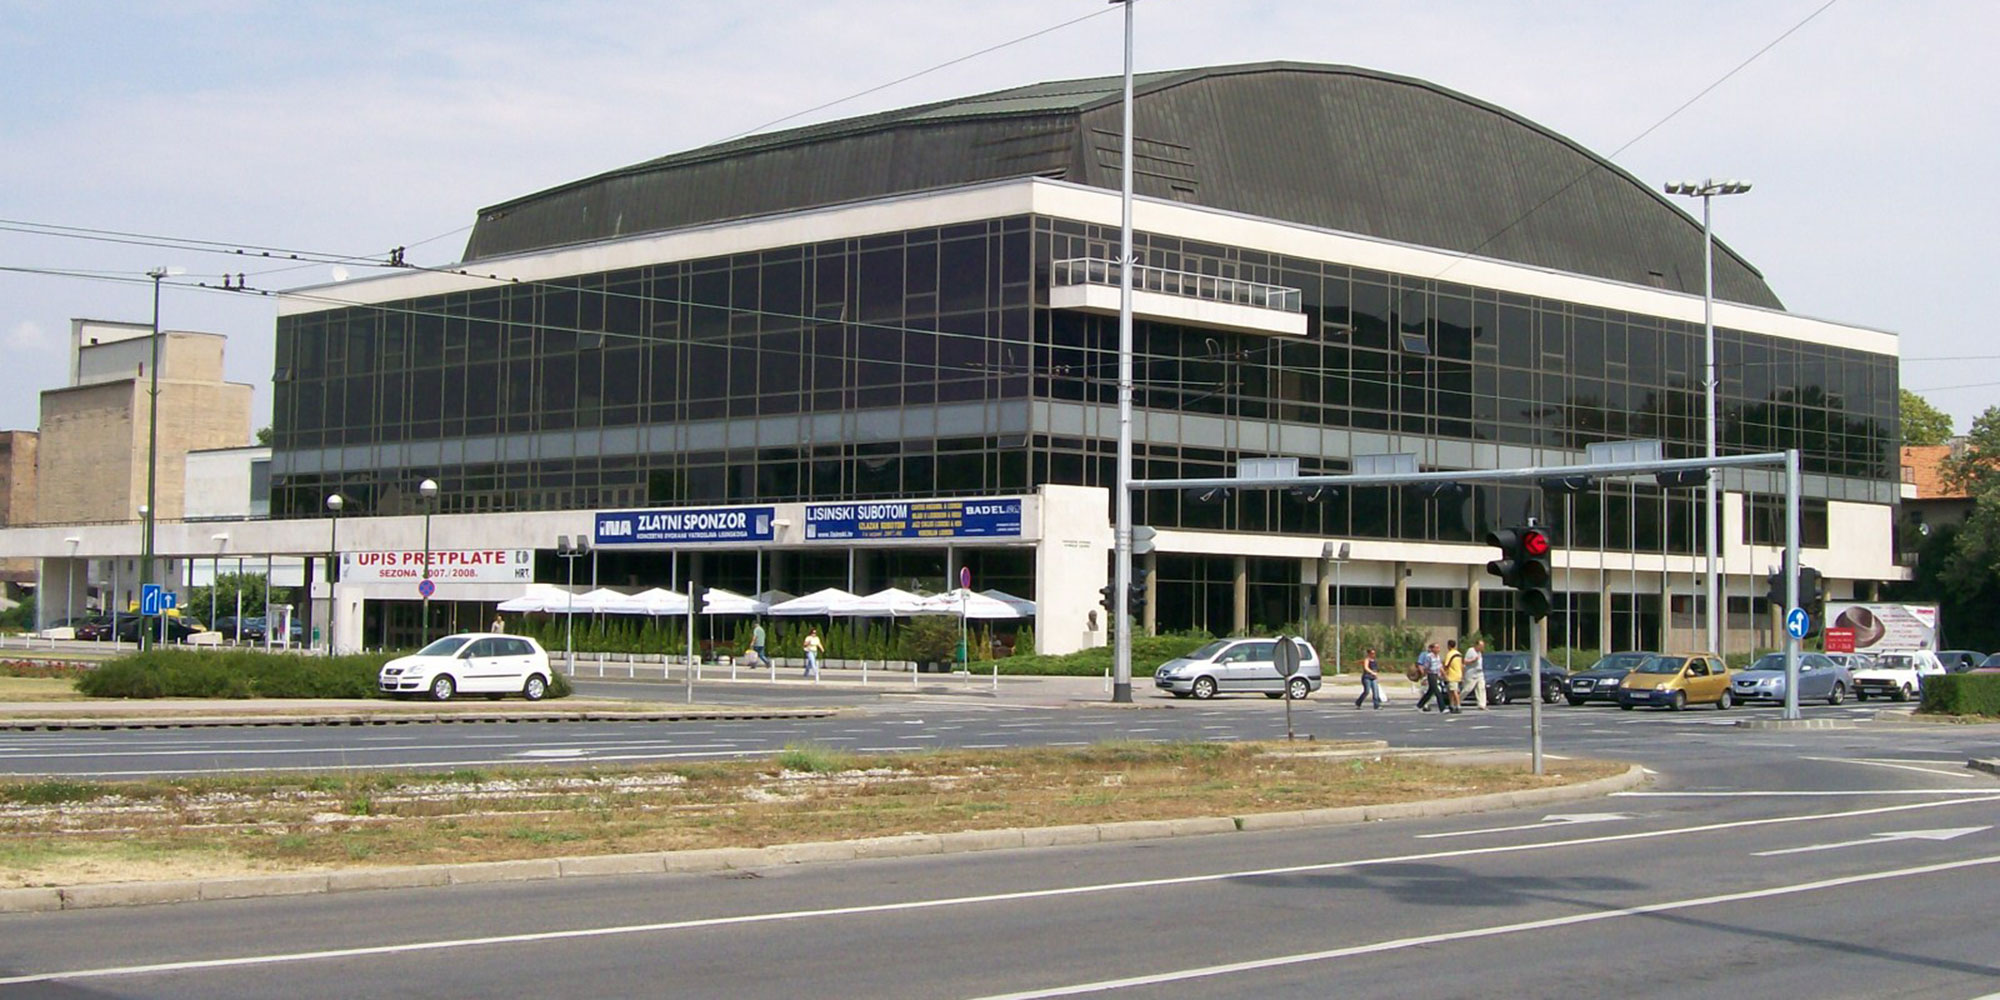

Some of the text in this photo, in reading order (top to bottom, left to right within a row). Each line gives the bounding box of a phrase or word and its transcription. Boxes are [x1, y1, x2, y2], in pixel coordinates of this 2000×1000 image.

[806, 507, 854, 521] LISINSKI
[857, 504, 907, 519] SUBOTOM
[965, 506, 1004, 515] BADEL
[637, 512, 746, 531] ZLATNI SPONZOR
[358, 551, 506, 565] UPIS PRETPLATE
[379, 569, 417, 578] SEZONA
